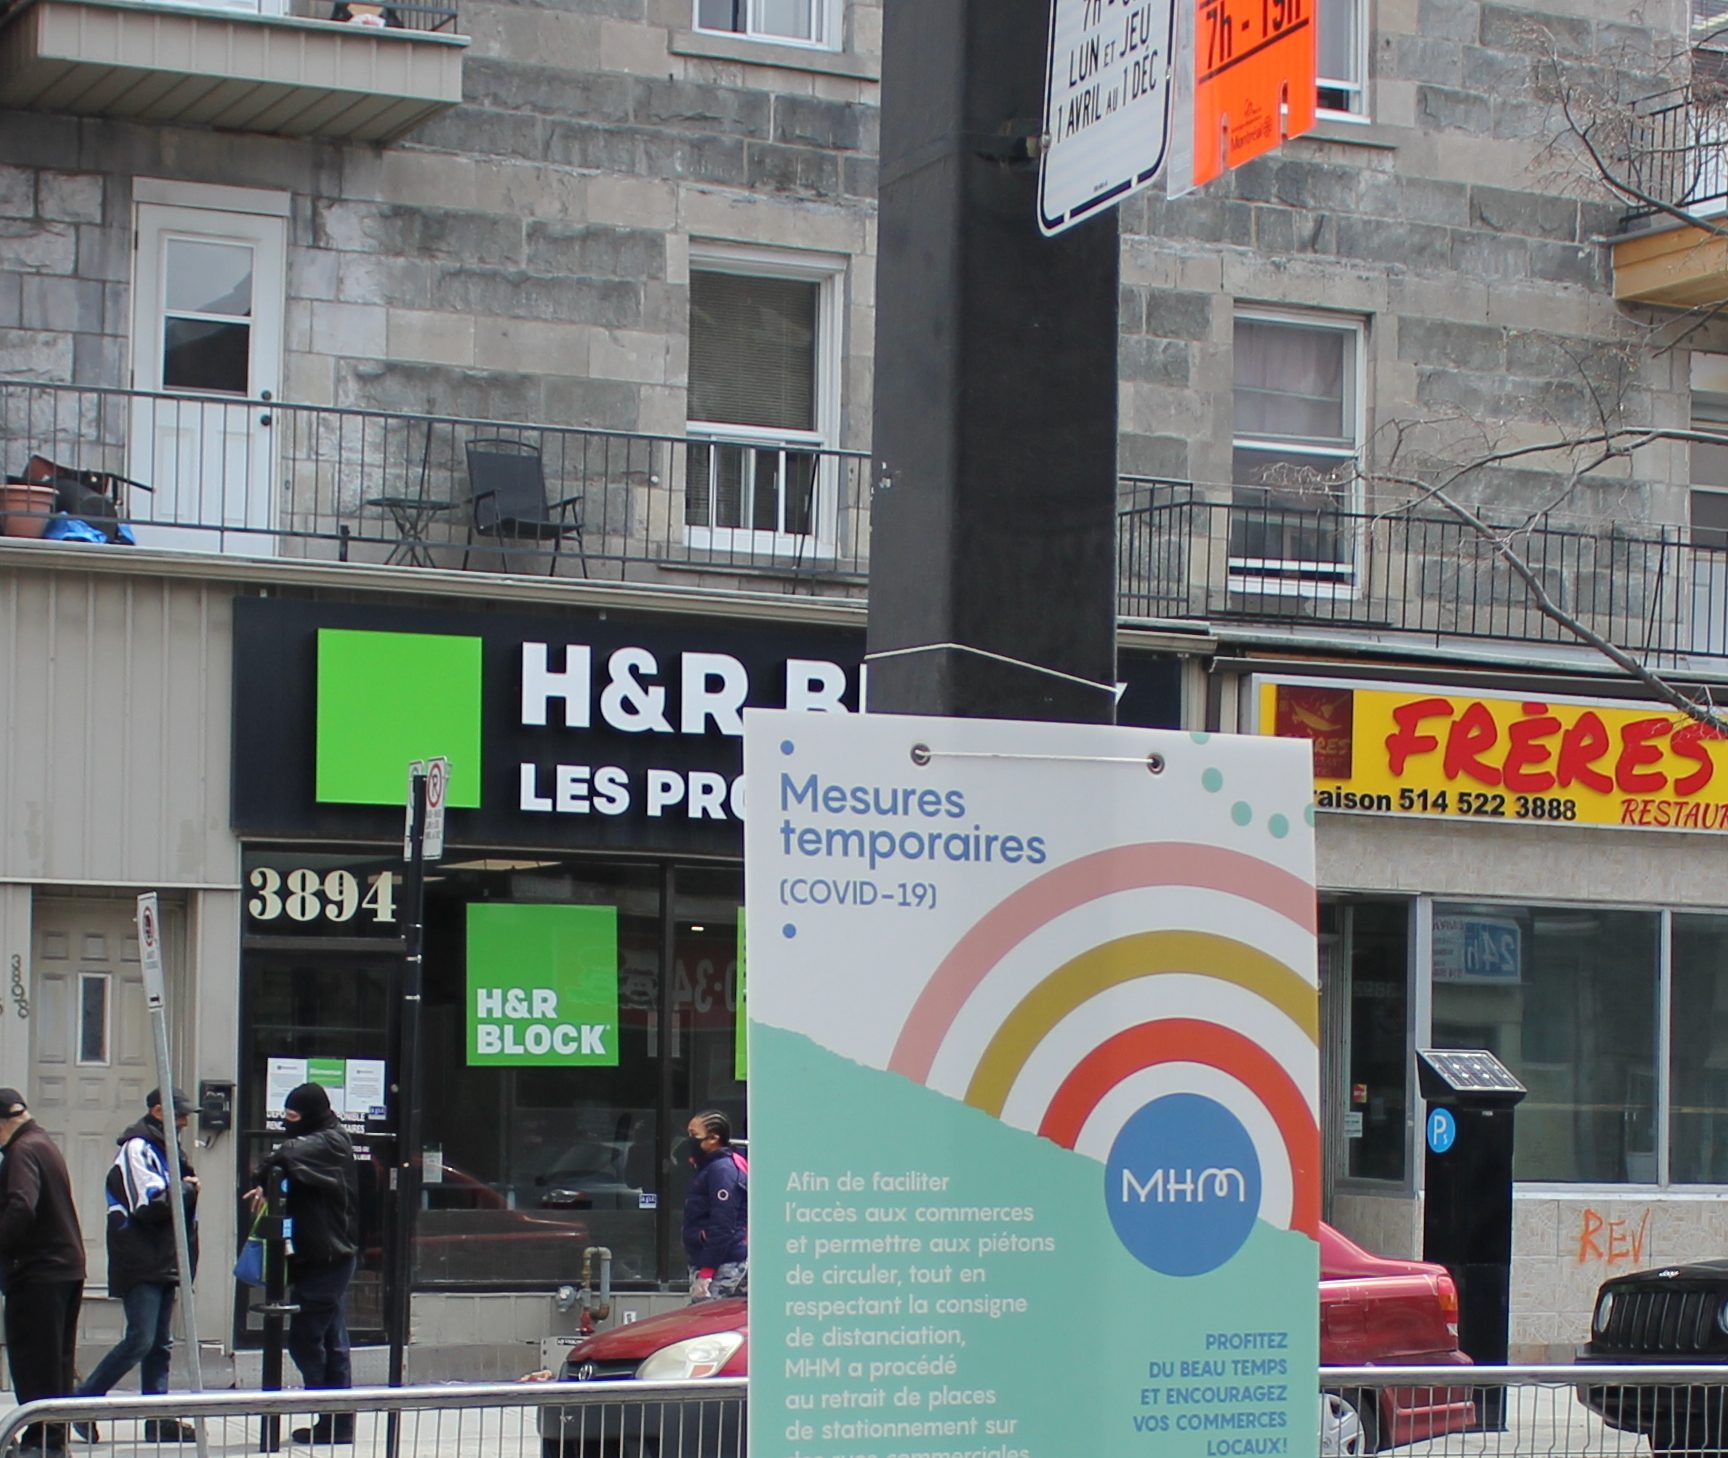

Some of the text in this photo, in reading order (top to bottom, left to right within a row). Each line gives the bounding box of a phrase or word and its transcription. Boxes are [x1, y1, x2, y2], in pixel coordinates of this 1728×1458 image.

[1068, 2, 1152, 89] LUN ET JEU
[1206, 0, 1232, 70] 7h
[1057, 44, 1159, 144] 1 AVRIL AU 1 DÉC
[522, 641, 749, 737] H&R
[1385, 698, 1728, 797] FRÈRES
[521, 762, 630, 817] LES
[780, 772, 966, 819] Mesures
[1314, 786, 1577, 822] aison 514 522 3888
[779, 818, 1047, 871] temporaires
[248, 867, 397, 923] 3894
[779, 877, 938, 910] (COVID-19)
[477, 988, 558, 1020] H&R
[477, 1025, 608, 1056] BLOCK
[786, 1171, 950, 1192] Afin de faciliter
[1122, 1167, 1245, 1203] MHM
[785, 1201, 1034, 1223] l'accès aux commerces
[785, 1230, 1056, 1260] et permettre aux piétons
[1578, 1207, 1651, 1265] REV
[785, 1264, 987, 1287] de circuler, tout en
[784, 1293, 1028, 1321] respectant la consigne
[785, 1325, 967, 1348] de distanciation,
[1205, 1331, 1288, 1351] PROFITEZ
[784, 1353, 958, 1382] MHM a procédé
[1148, 1358, 1288, 1379] DU BEAU TEMPS
[785, 1385, 997, 1412] au retrait de places
[1140, 1385, 1288, 1405] ET ENCOURAGEZ
[785, 1416, 1018, 1441] de stationnement sur
[1132, 1411, 1288, 1433] VOS COMMERCES
[1206, 1437, 1288, 1457] LOCAUX!
